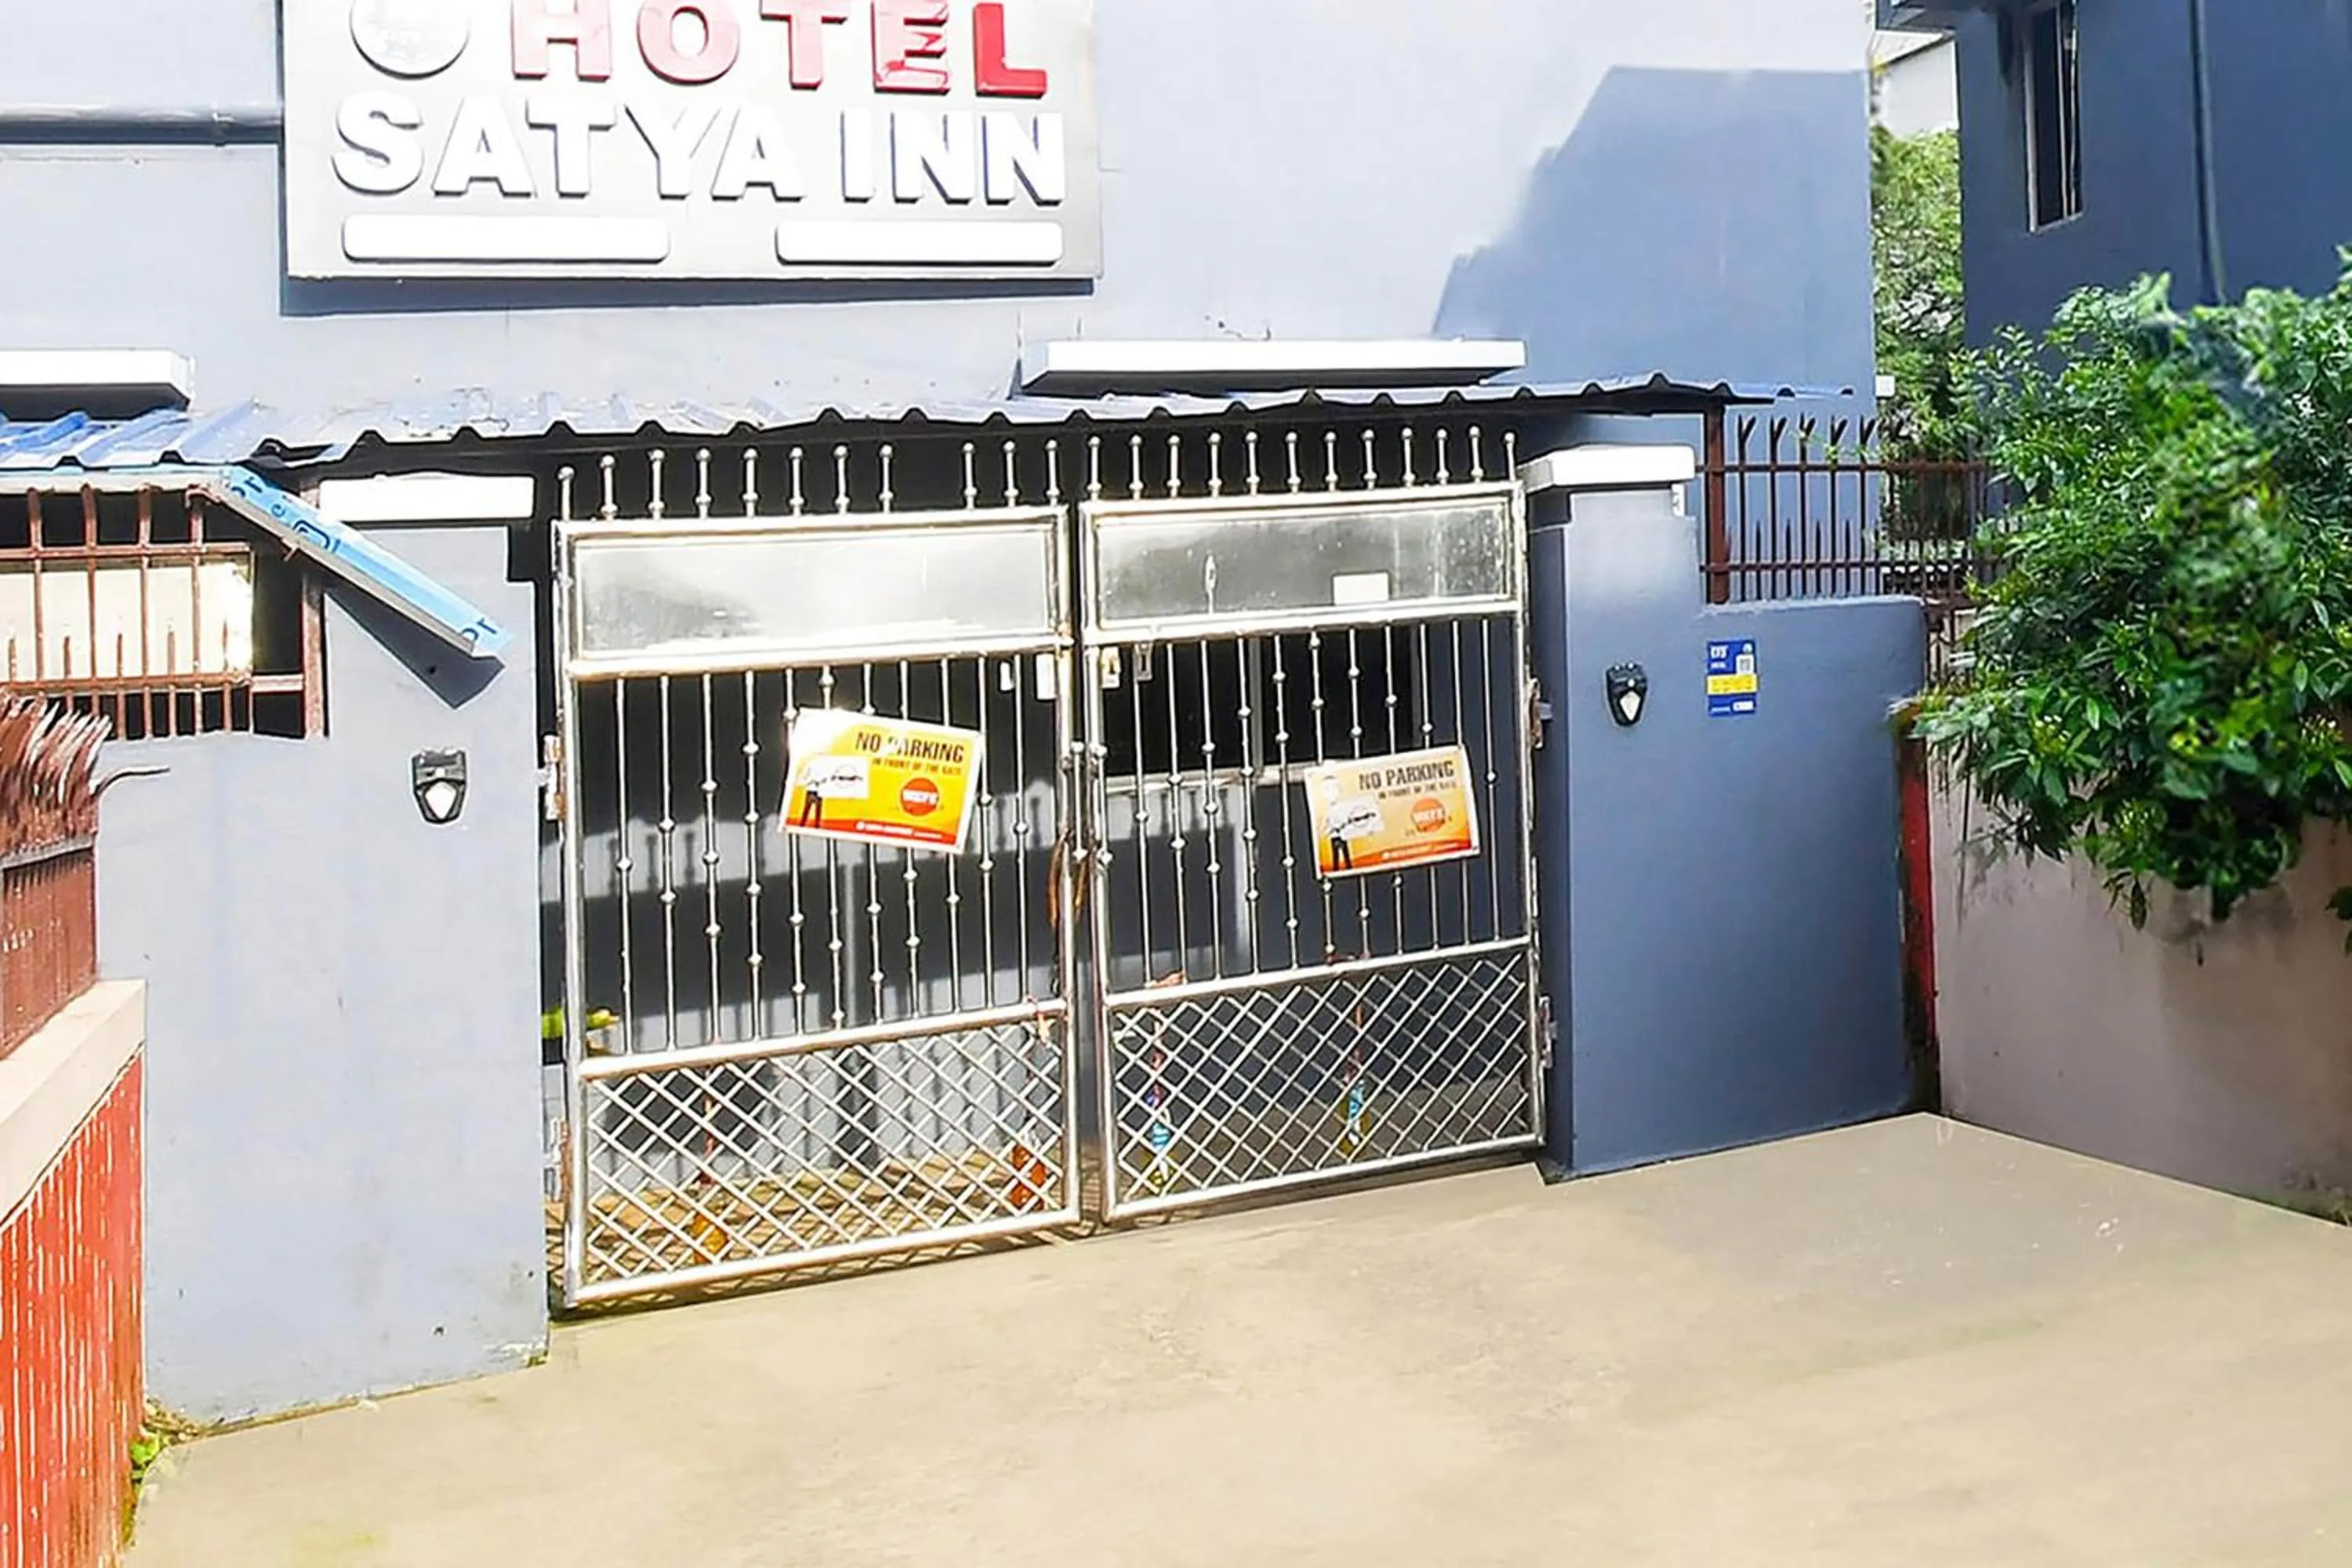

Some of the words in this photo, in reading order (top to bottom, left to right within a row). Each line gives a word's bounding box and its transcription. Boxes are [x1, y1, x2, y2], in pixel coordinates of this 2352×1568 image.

[510, 0, 1047, 97] HOTEL
[332, 90, 804, 201] SATYA
[840, 108, 1065, 206] INN
[855, 731, 881, 753] NO
[1358, 771, 1382, 791] NO
[1386, 760, 1454, 786] PARKING
